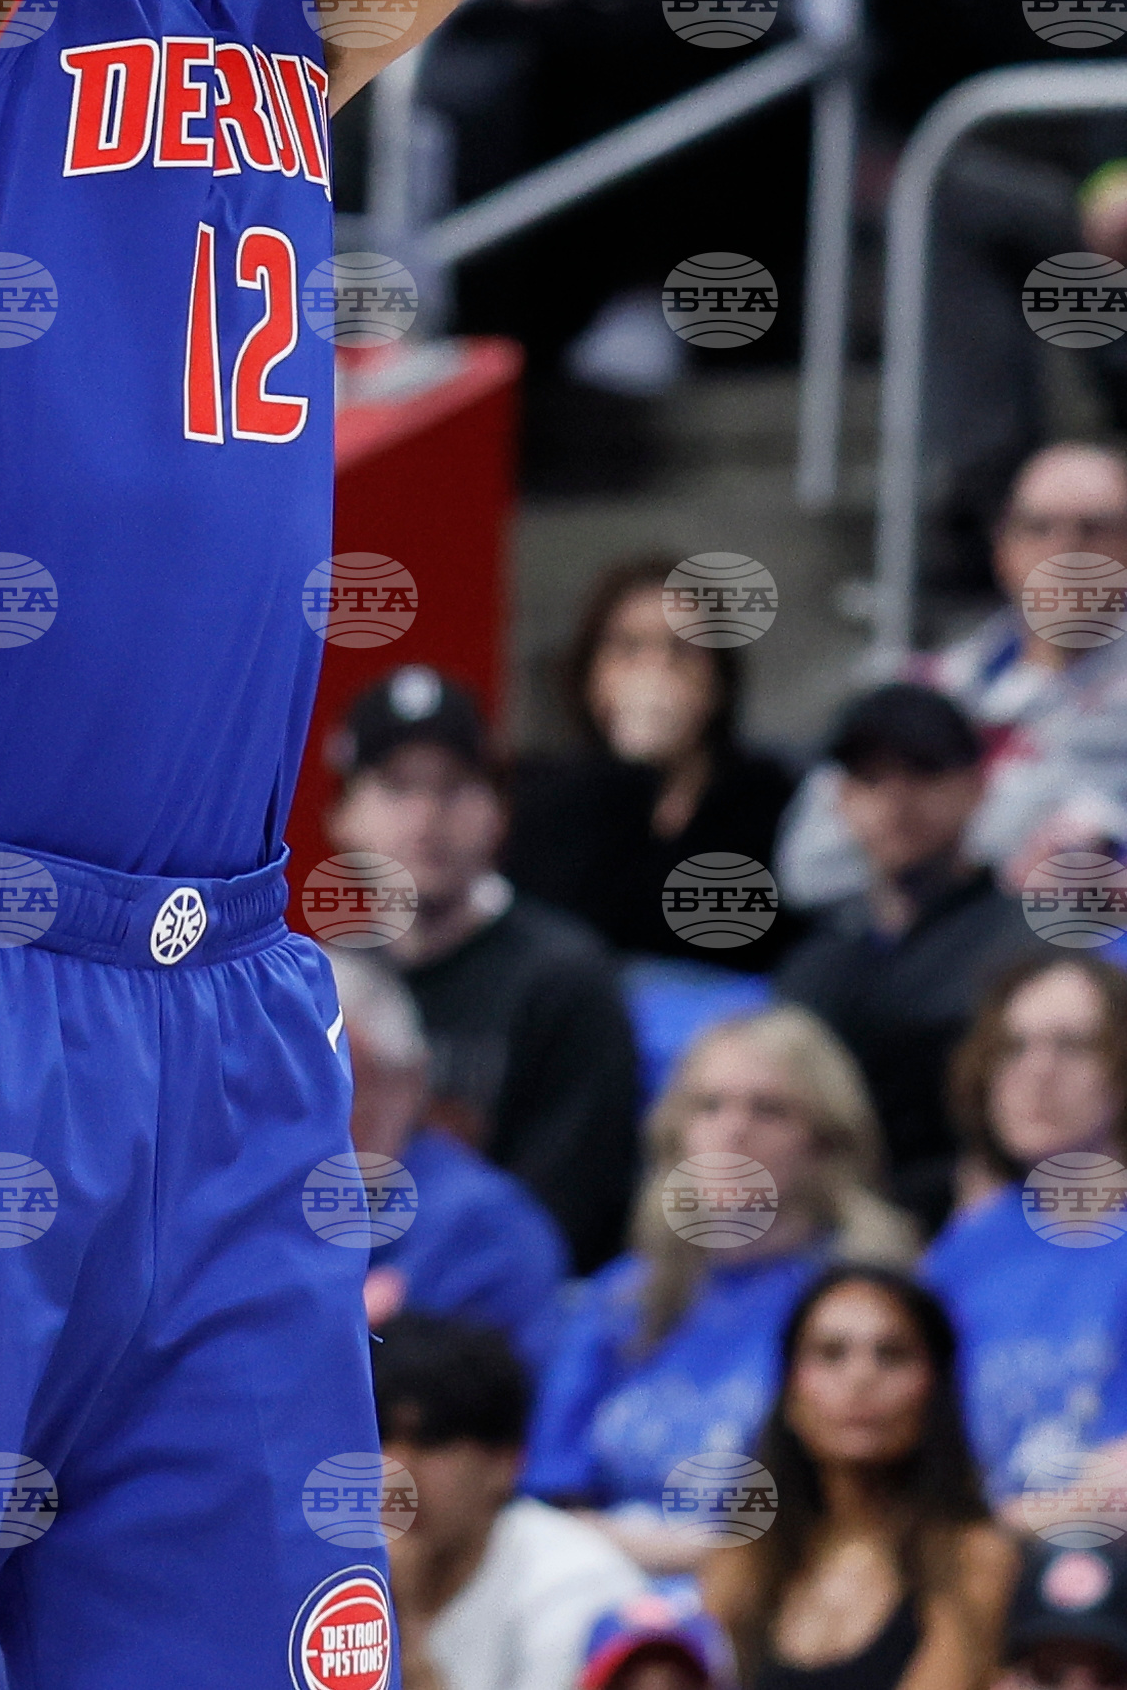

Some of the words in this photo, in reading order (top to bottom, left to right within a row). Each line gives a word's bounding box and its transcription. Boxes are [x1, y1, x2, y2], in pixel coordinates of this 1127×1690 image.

[184, 221, 309, 444] 12
[320, 1618, 384, 1651] DETROIT
[320, 1644, 384, 1679] PISTONS
